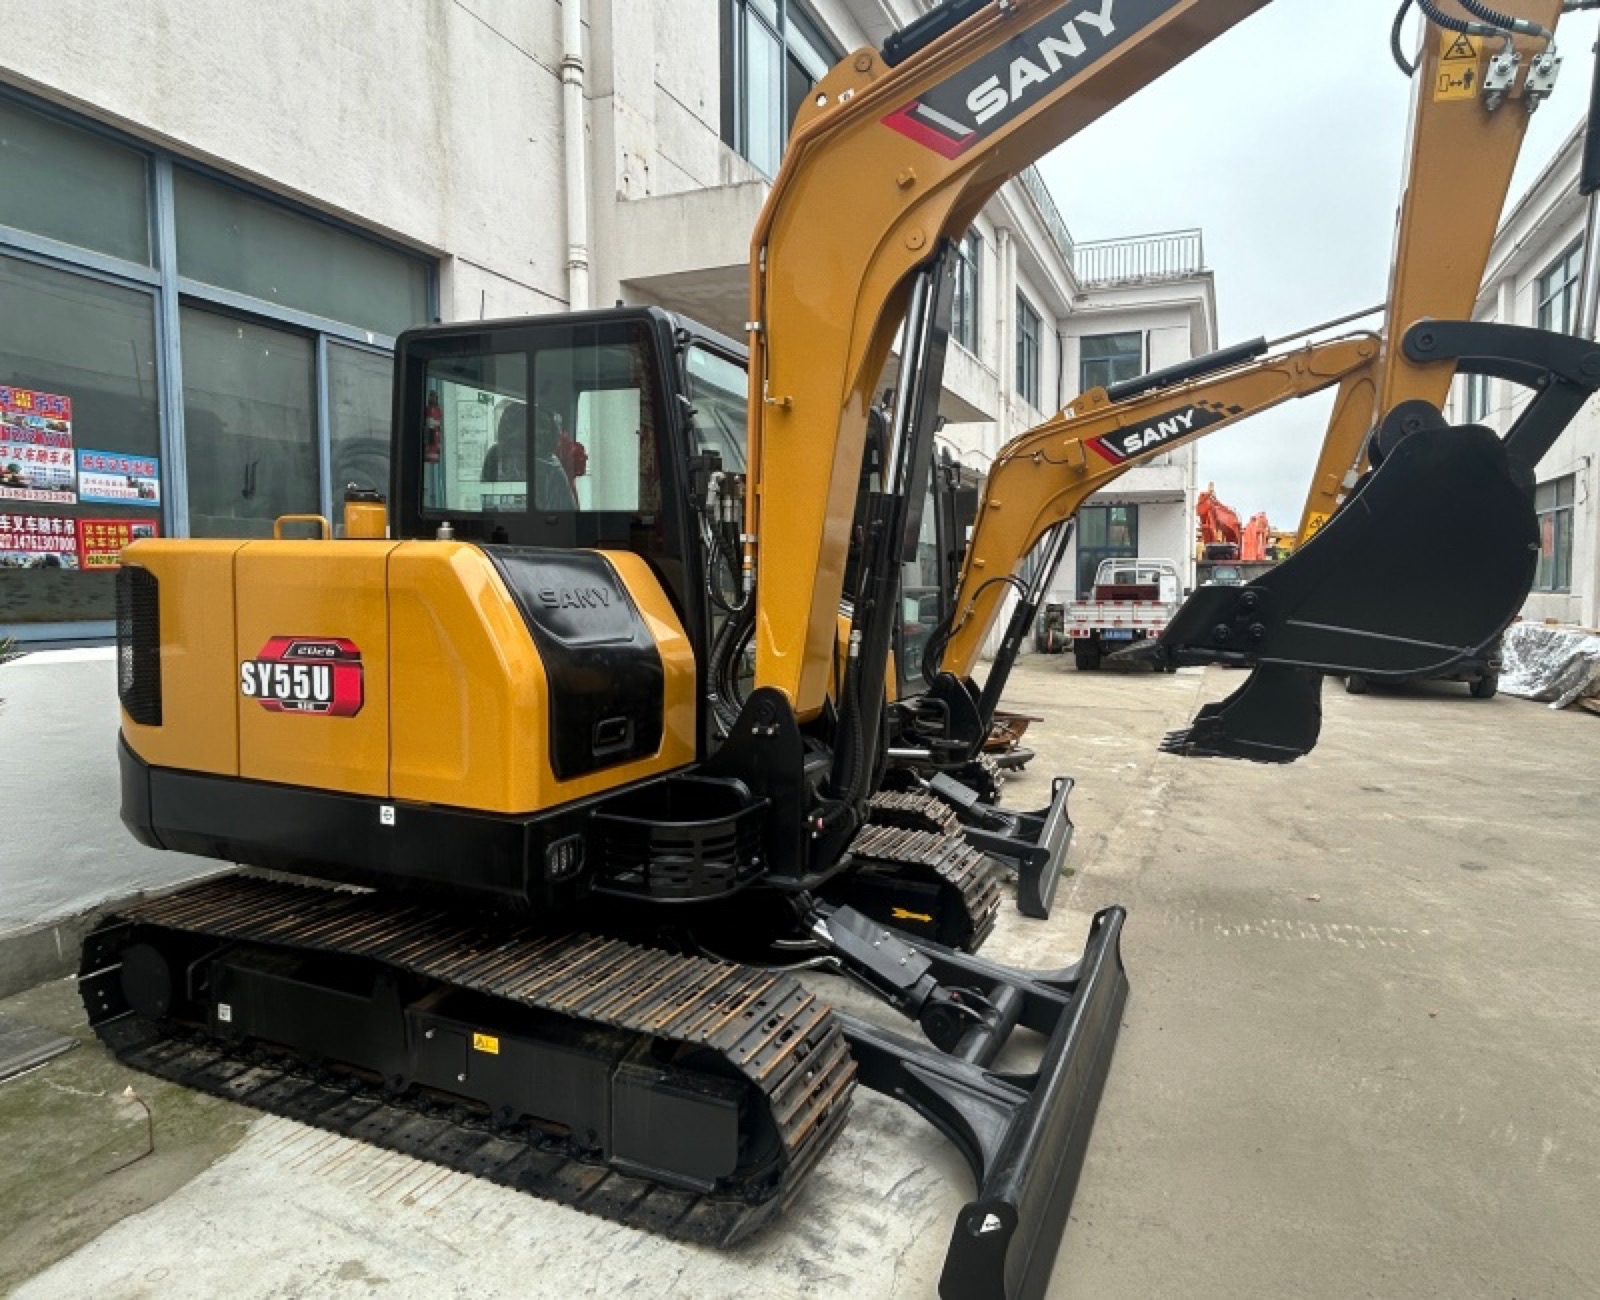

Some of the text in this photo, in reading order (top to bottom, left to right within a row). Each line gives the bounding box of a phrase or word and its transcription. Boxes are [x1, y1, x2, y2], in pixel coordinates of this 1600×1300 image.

[966, 0, 1116, 125] SANY
[1123, 408, 1194, 453] SANY
[537, 588, 610, 608] SANY
[241, 662, 329, 701] SY55U
